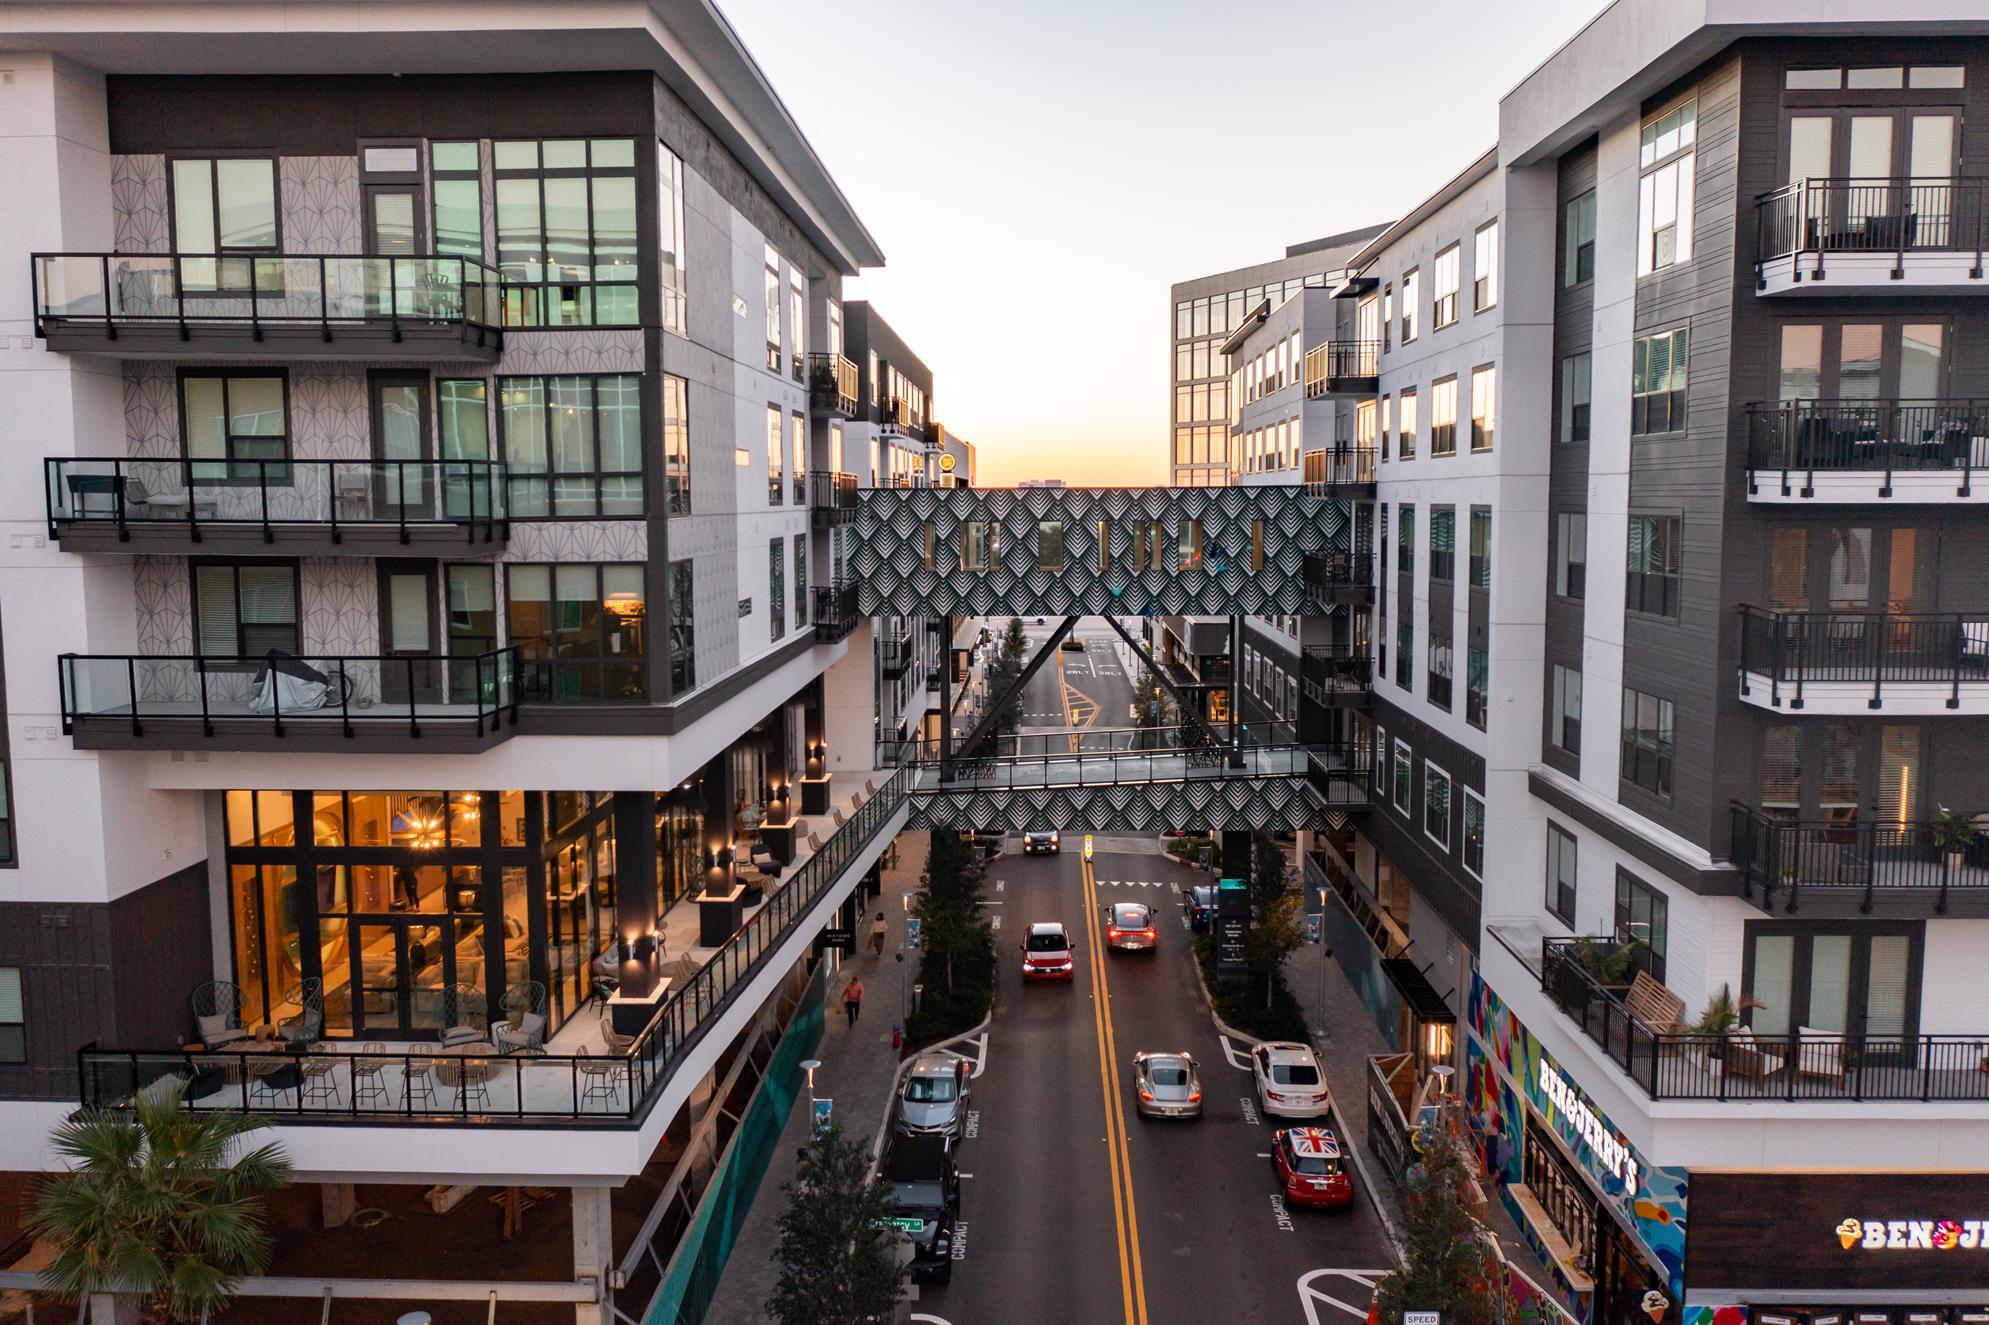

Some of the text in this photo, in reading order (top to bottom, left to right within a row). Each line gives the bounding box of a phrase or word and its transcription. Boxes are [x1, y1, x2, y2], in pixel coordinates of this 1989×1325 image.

[966, 1110, 980, 1138] COMPACT
[1240, 1097, 1259, 1125] COMPACT
[1270, 1194, 1294, 1232] COMPACT
[951, 1221, 969, 1260] COMPACT
